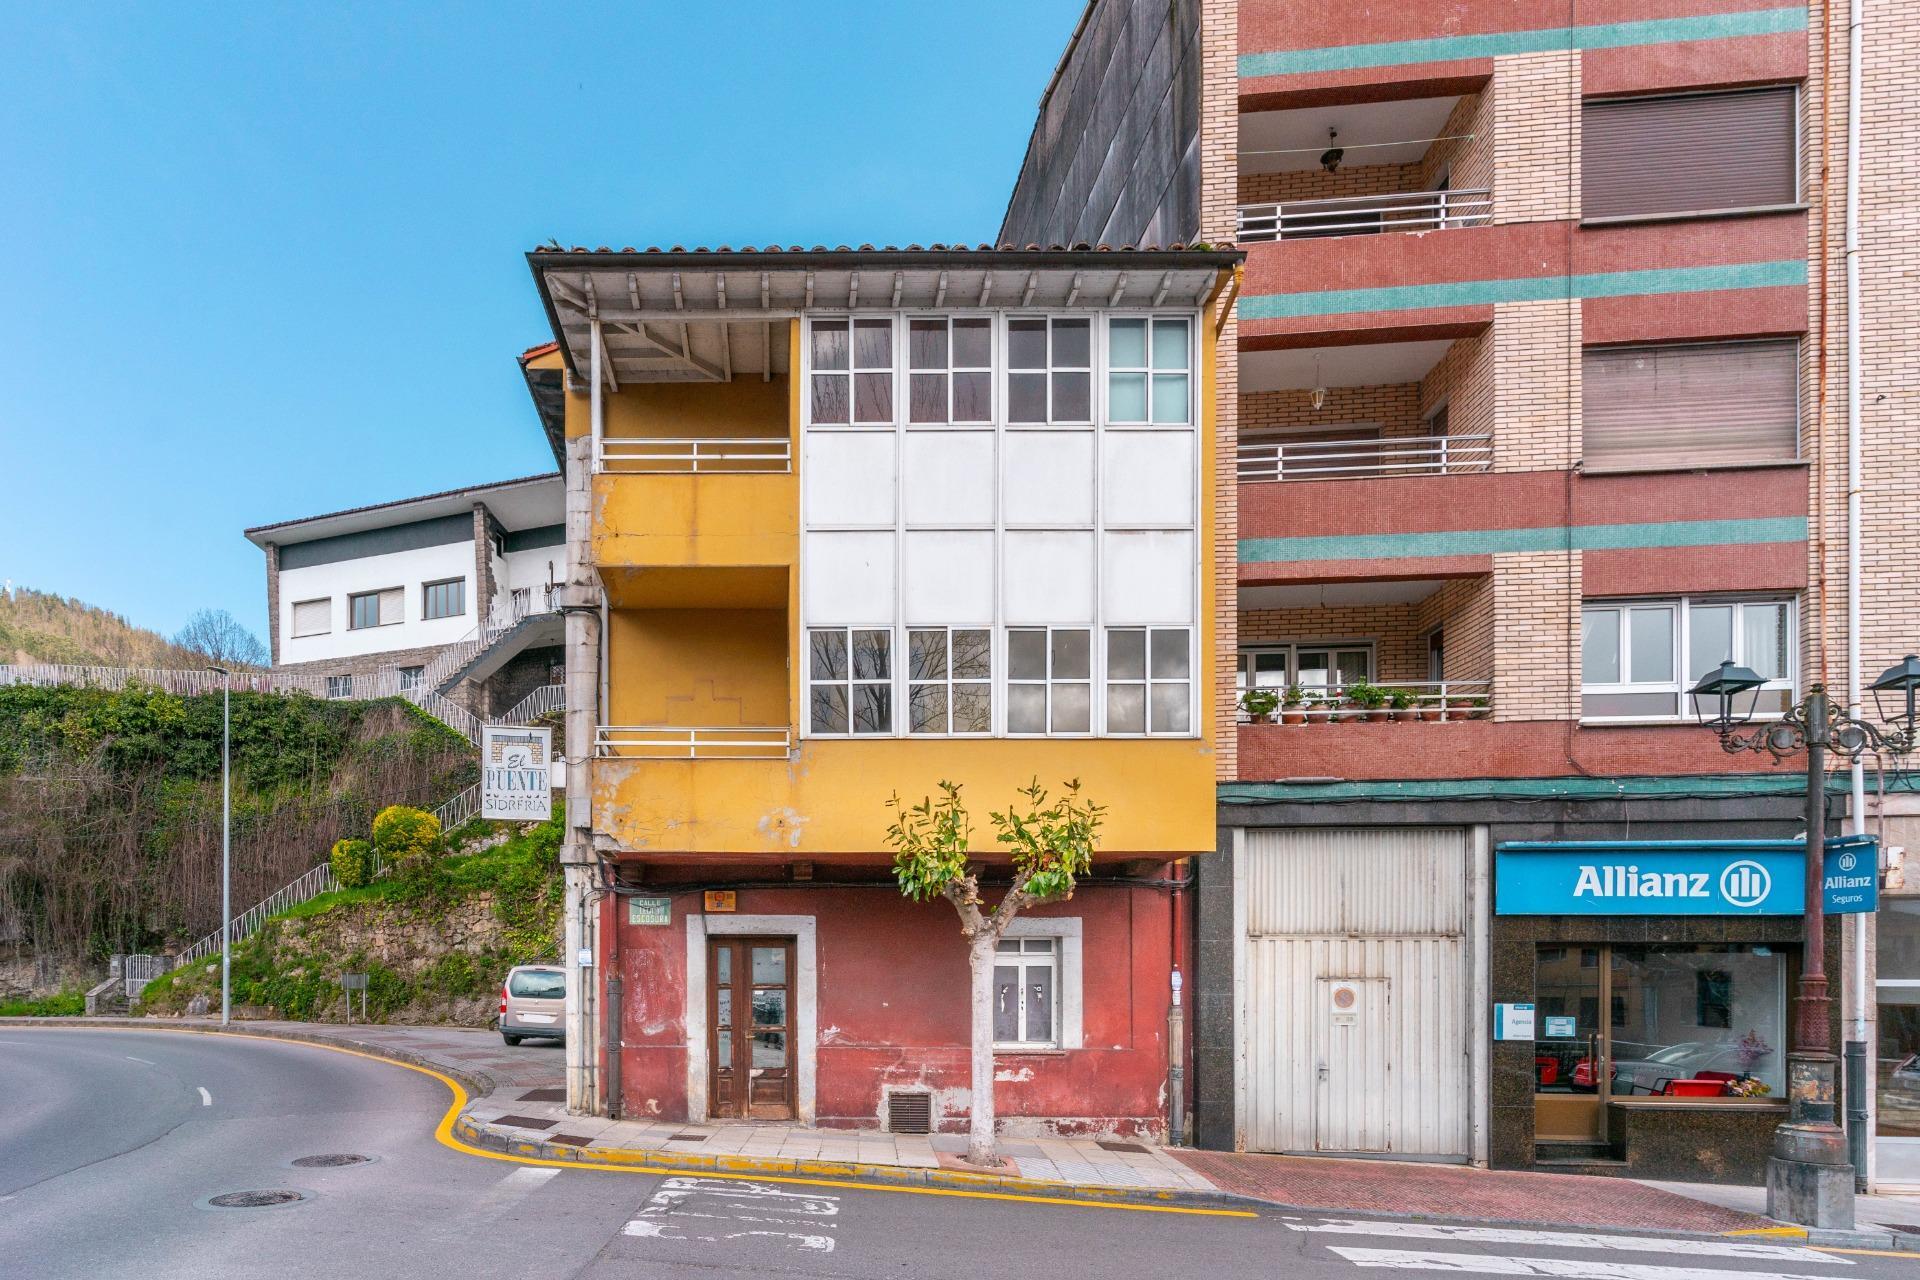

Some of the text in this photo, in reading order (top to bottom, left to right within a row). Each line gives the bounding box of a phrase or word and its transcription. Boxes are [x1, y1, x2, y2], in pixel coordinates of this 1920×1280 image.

[508, 754, 525, 768] El
[487, 770, 547, 791] PUENTE
[1573, 866, 1709, 898] Allianz
[1824, 875, 1871, 891] Allianz
[1832, 894, 1863, 905] Seguros
